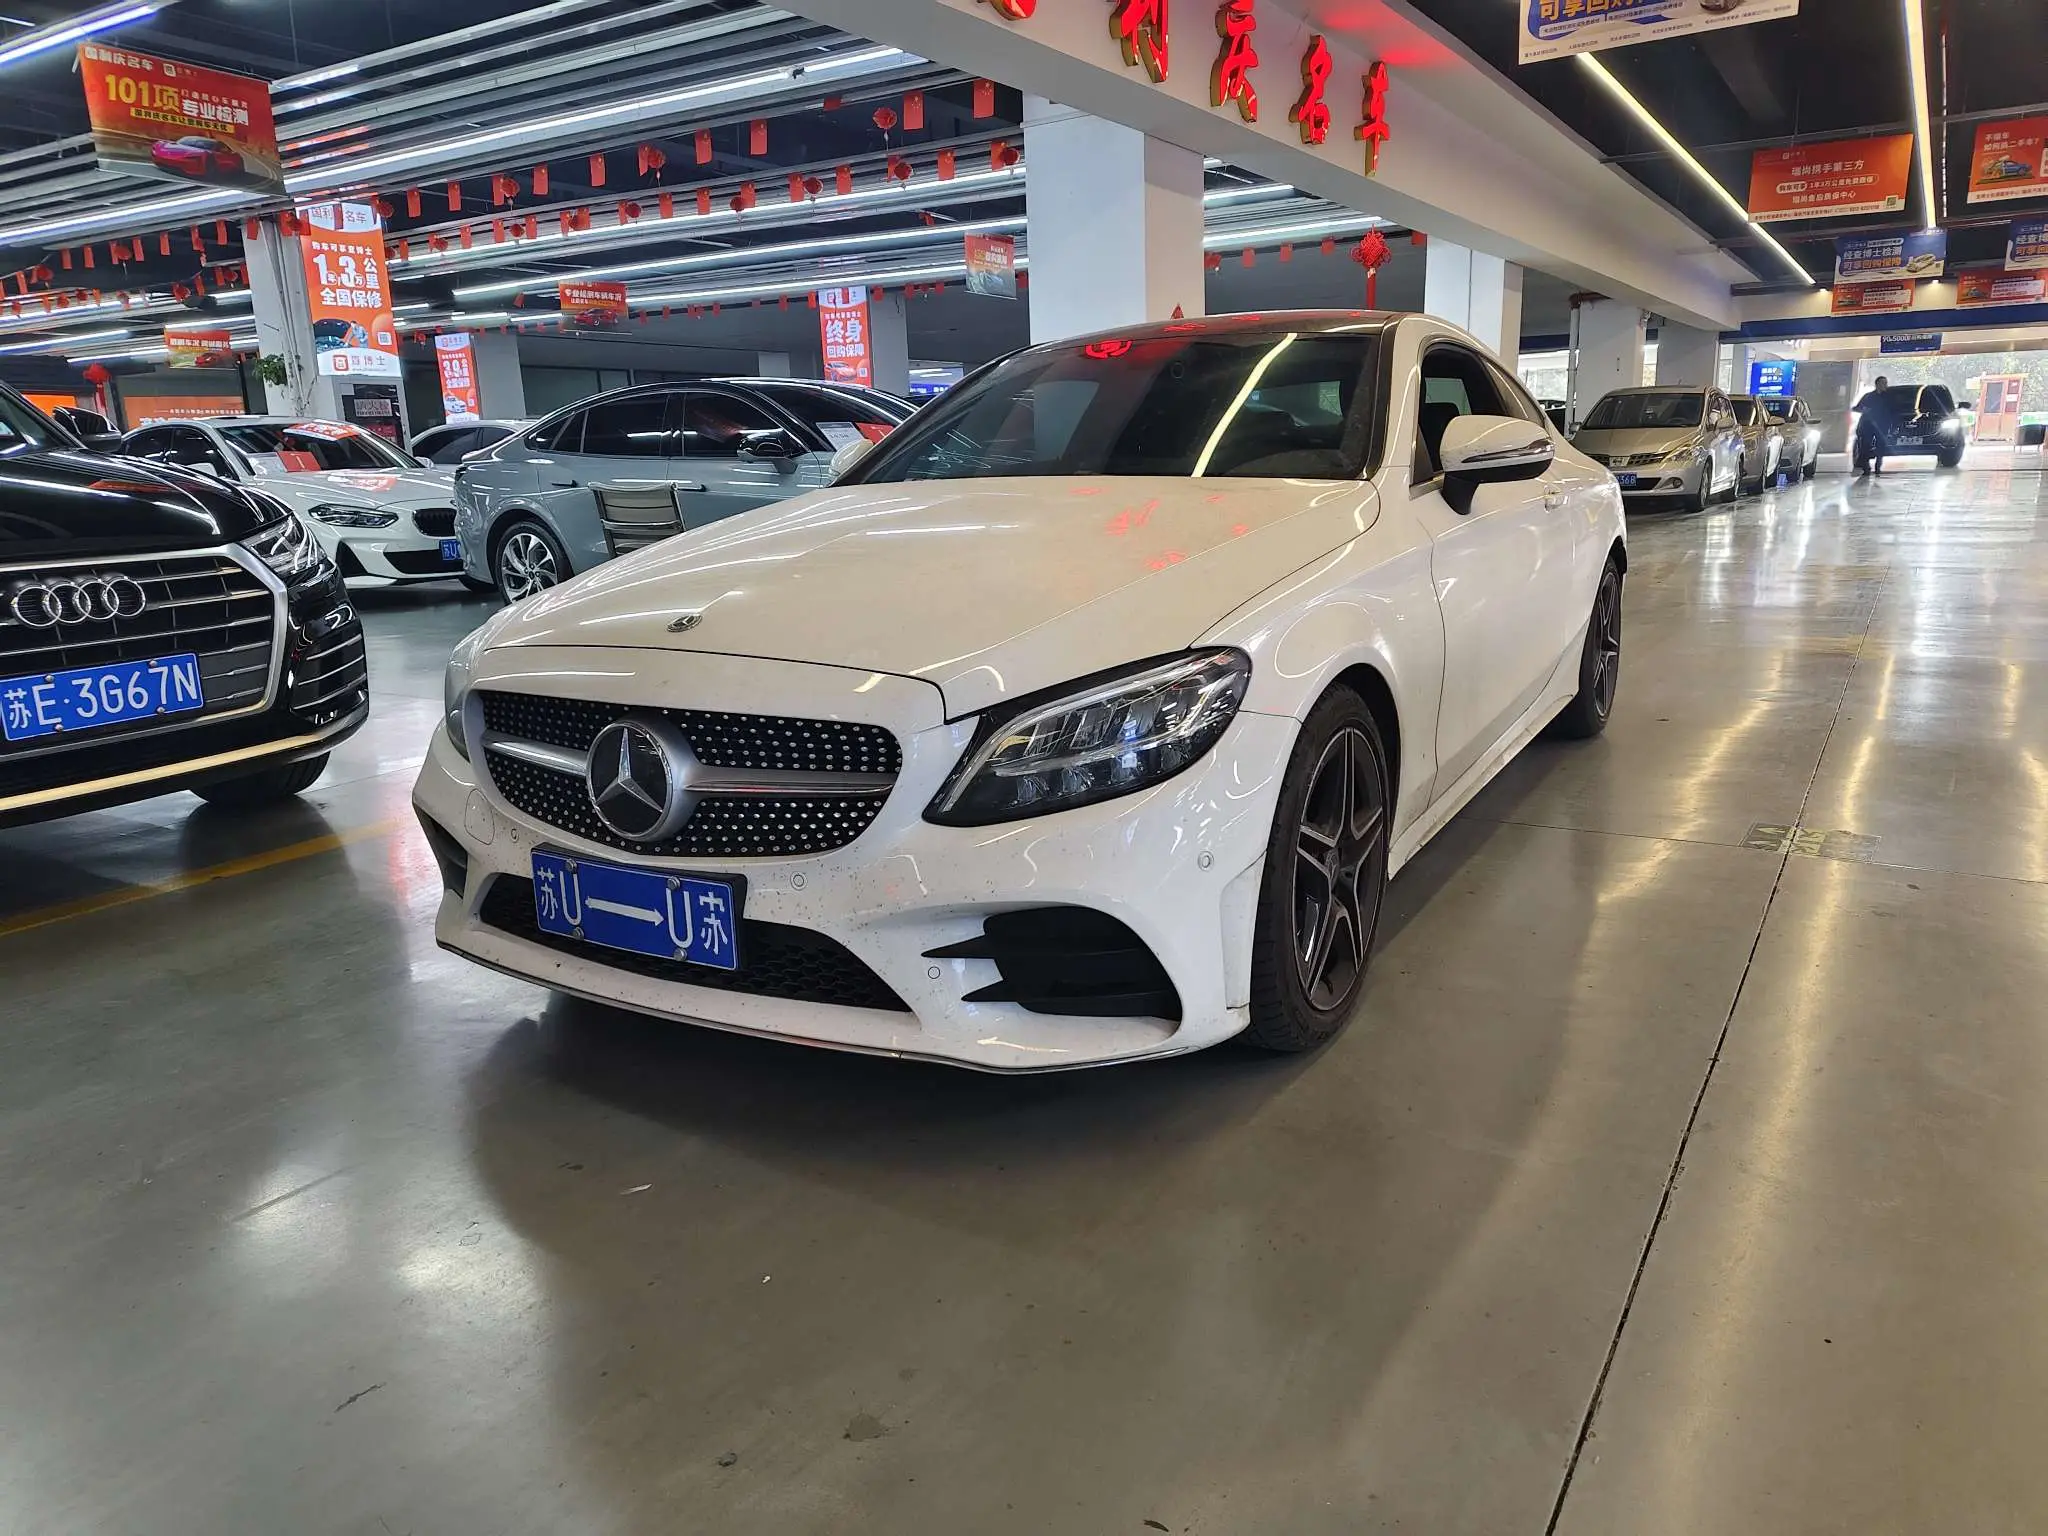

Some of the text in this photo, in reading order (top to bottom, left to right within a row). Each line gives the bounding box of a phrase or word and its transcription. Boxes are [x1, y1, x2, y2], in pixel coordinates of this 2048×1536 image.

[105, 73, 180, 113] 101项
[181, 98, 249, 126] 专业检测
[319, 287, 383, 309] 全国保修
[826, 319, 862, 344] 终身
[826, 343, 865, 358] 回购保障
